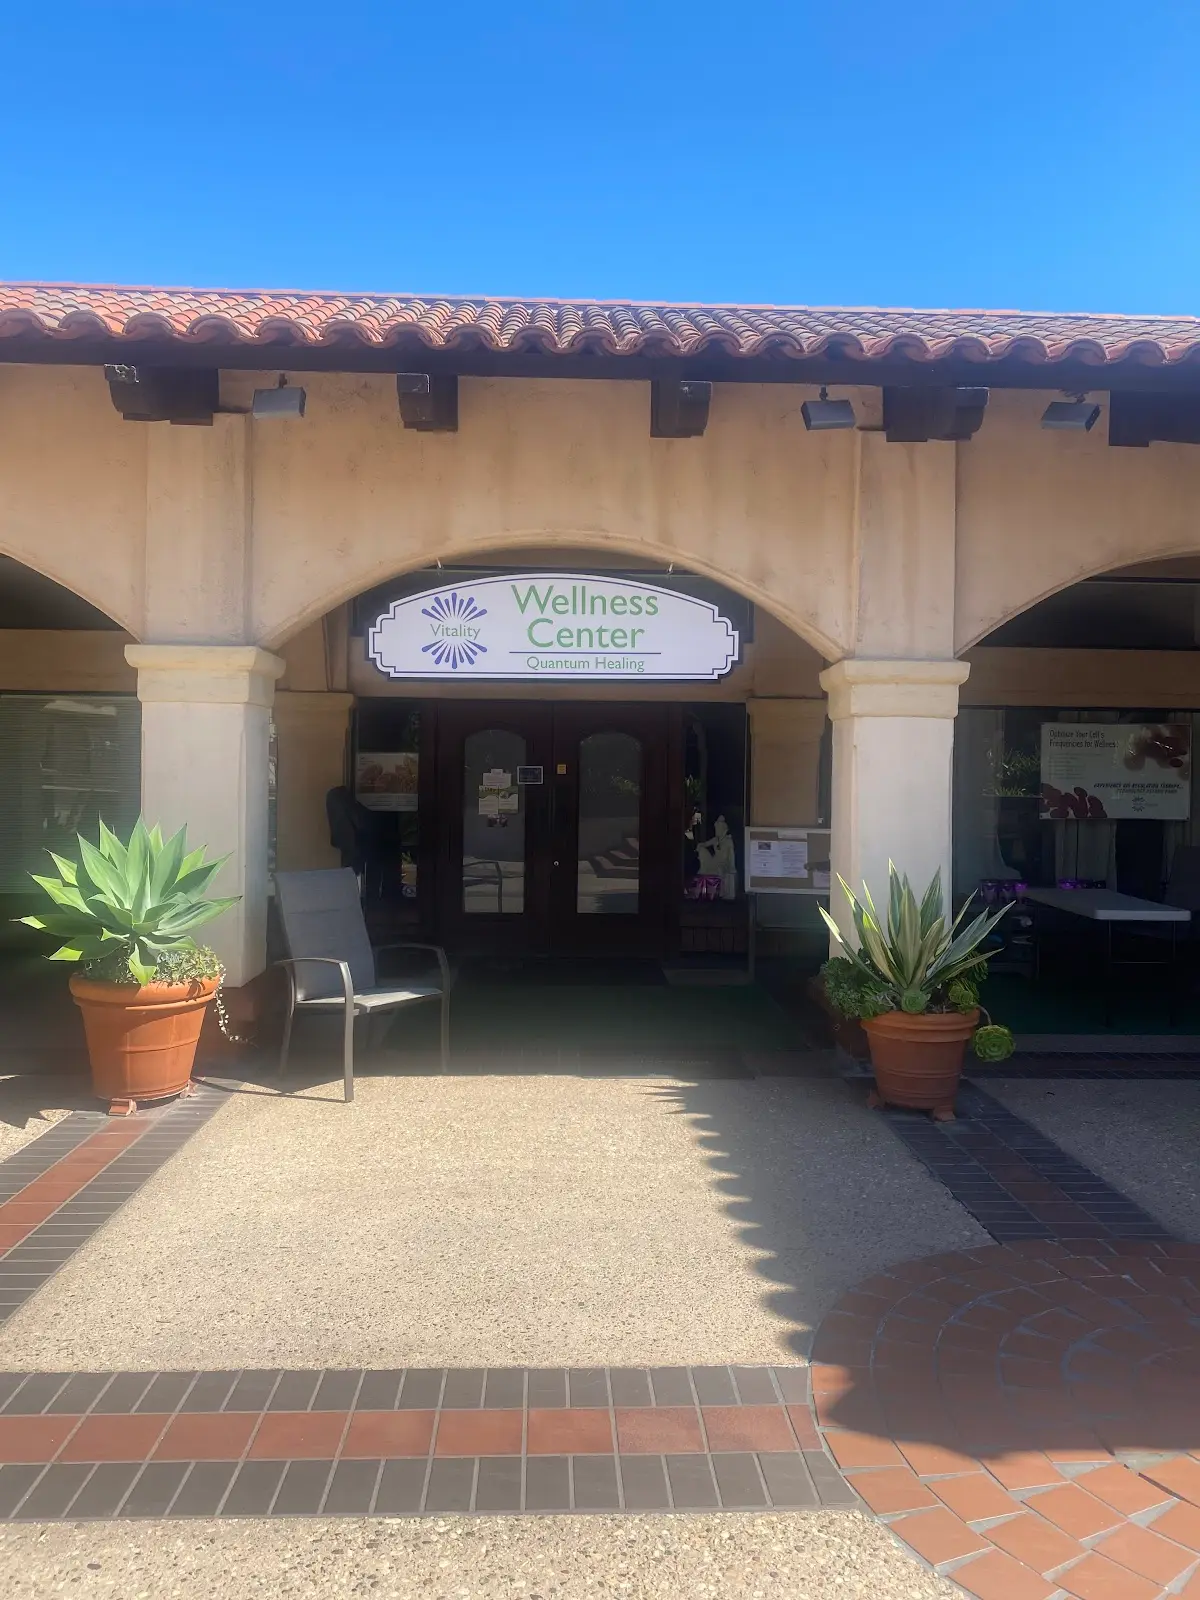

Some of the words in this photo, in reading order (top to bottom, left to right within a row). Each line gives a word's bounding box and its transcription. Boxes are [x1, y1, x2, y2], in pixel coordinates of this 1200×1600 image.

[510, 584, 659, 616] Wellness
[429, 623, 481, 641] Vitality
[527, 617, 645, 649] Center
[526, 656, 590, 671] Quantum
[594, 656, 645, 673] Healing
[1076, 730, 1088, 738] Your
[1049, 739, 1083, 750] Frequencies
[1084, 739, 1093, 748] for
